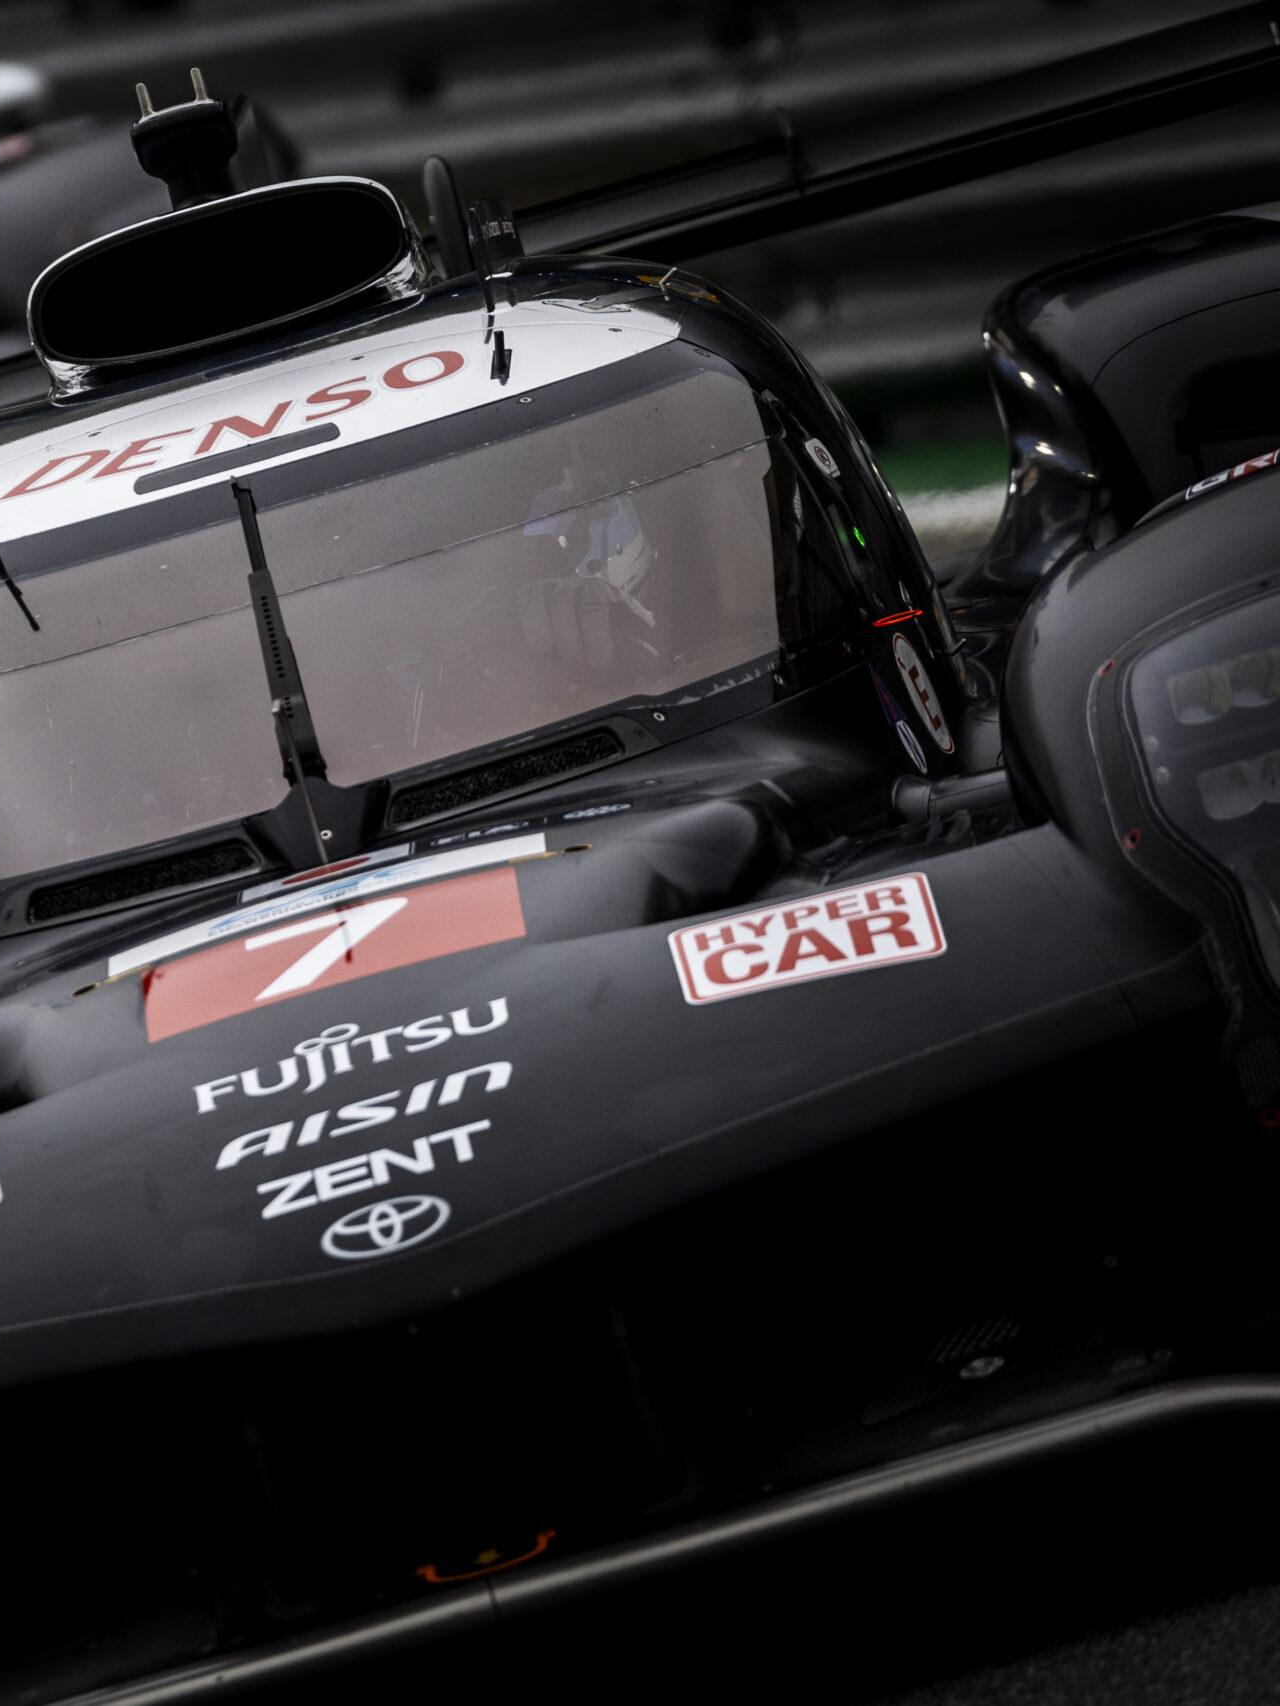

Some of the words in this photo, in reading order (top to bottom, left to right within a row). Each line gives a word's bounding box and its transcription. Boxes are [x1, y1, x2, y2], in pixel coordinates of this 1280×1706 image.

[0, 350, 466, 501] DENSO
[1191, 451, 1274, 493] GR
[244, 896, 409, 1002] 7
[694, 885, 908, 952] HYPER
[704, 910, 920, 986] CAR
[193, 996, 510, 1114] FUJITSU
[215, 1060, 514, 1171] AISIN
[256, 1118, 492, 1220] ZENT
